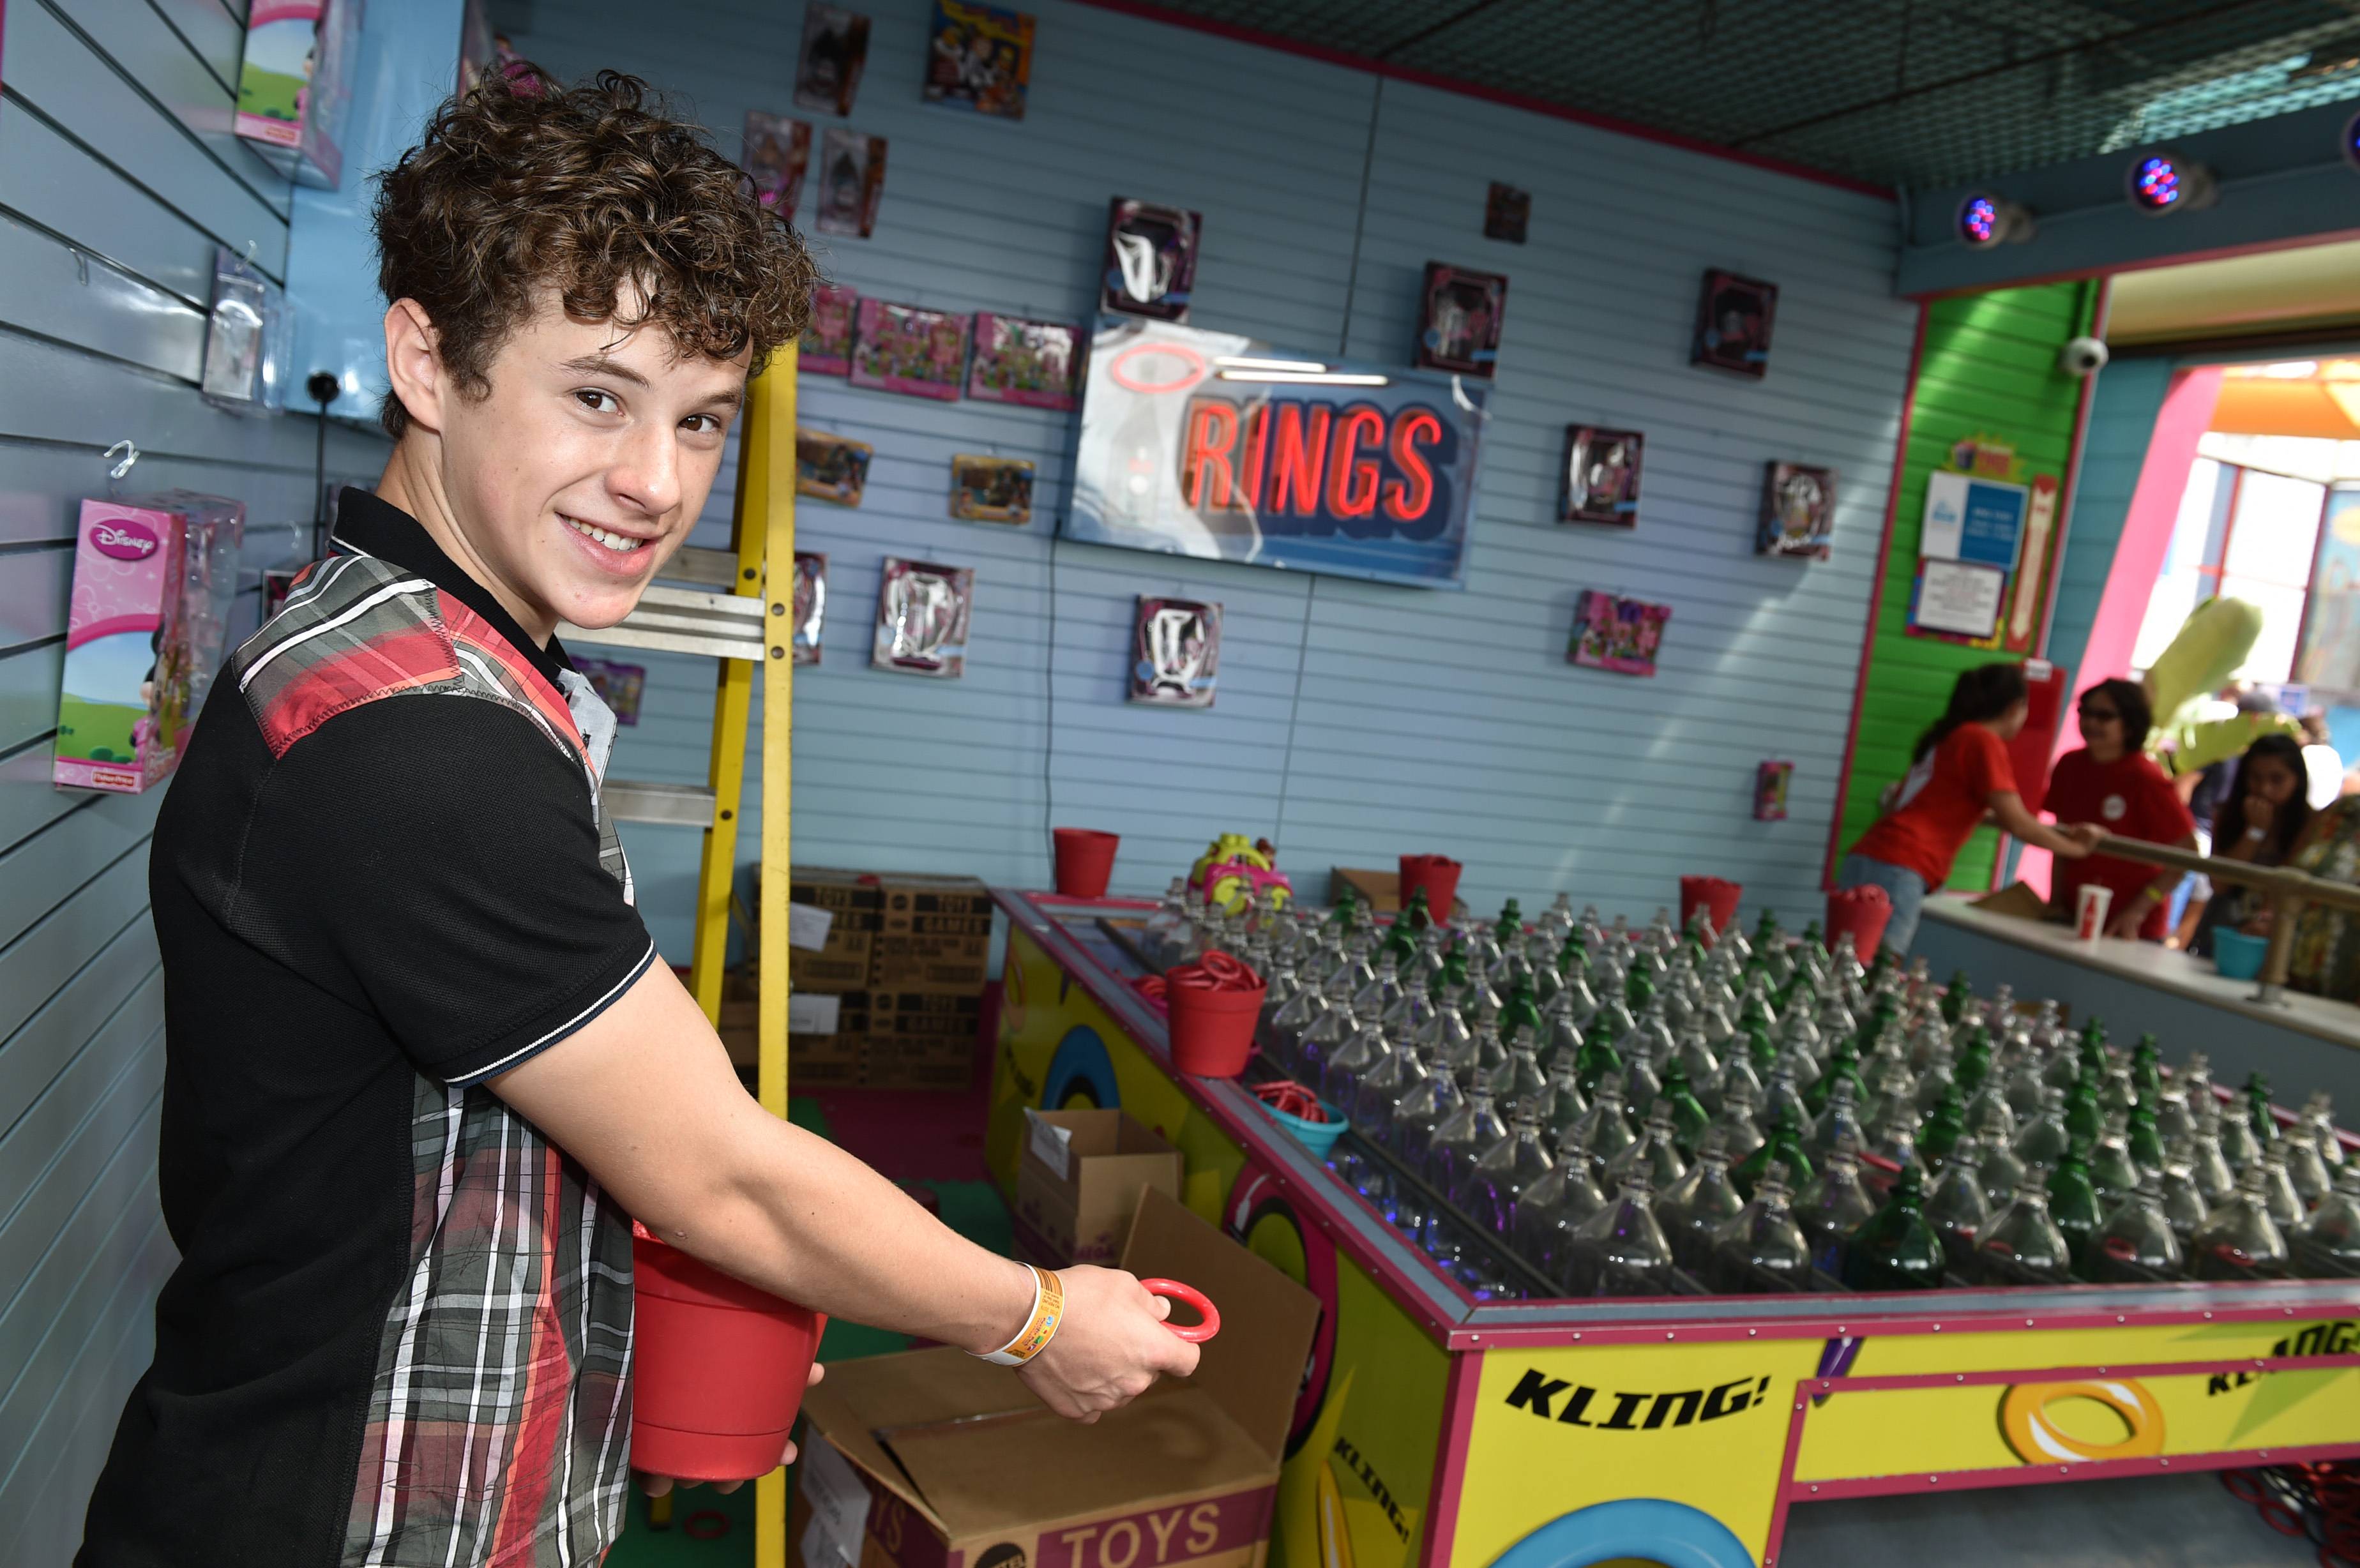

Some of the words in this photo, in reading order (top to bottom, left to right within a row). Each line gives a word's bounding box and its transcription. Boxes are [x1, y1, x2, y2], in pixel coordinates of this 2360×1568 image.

[1183, 401, 1442, 521] RINGS
[93, 524, 155, 554] Disney
[1504, 1368, 1772, 1431] KLING!
[1334, 1436, 1409, 1545] KLING!
[1061, 1515, 1220, 1568] TOYS
